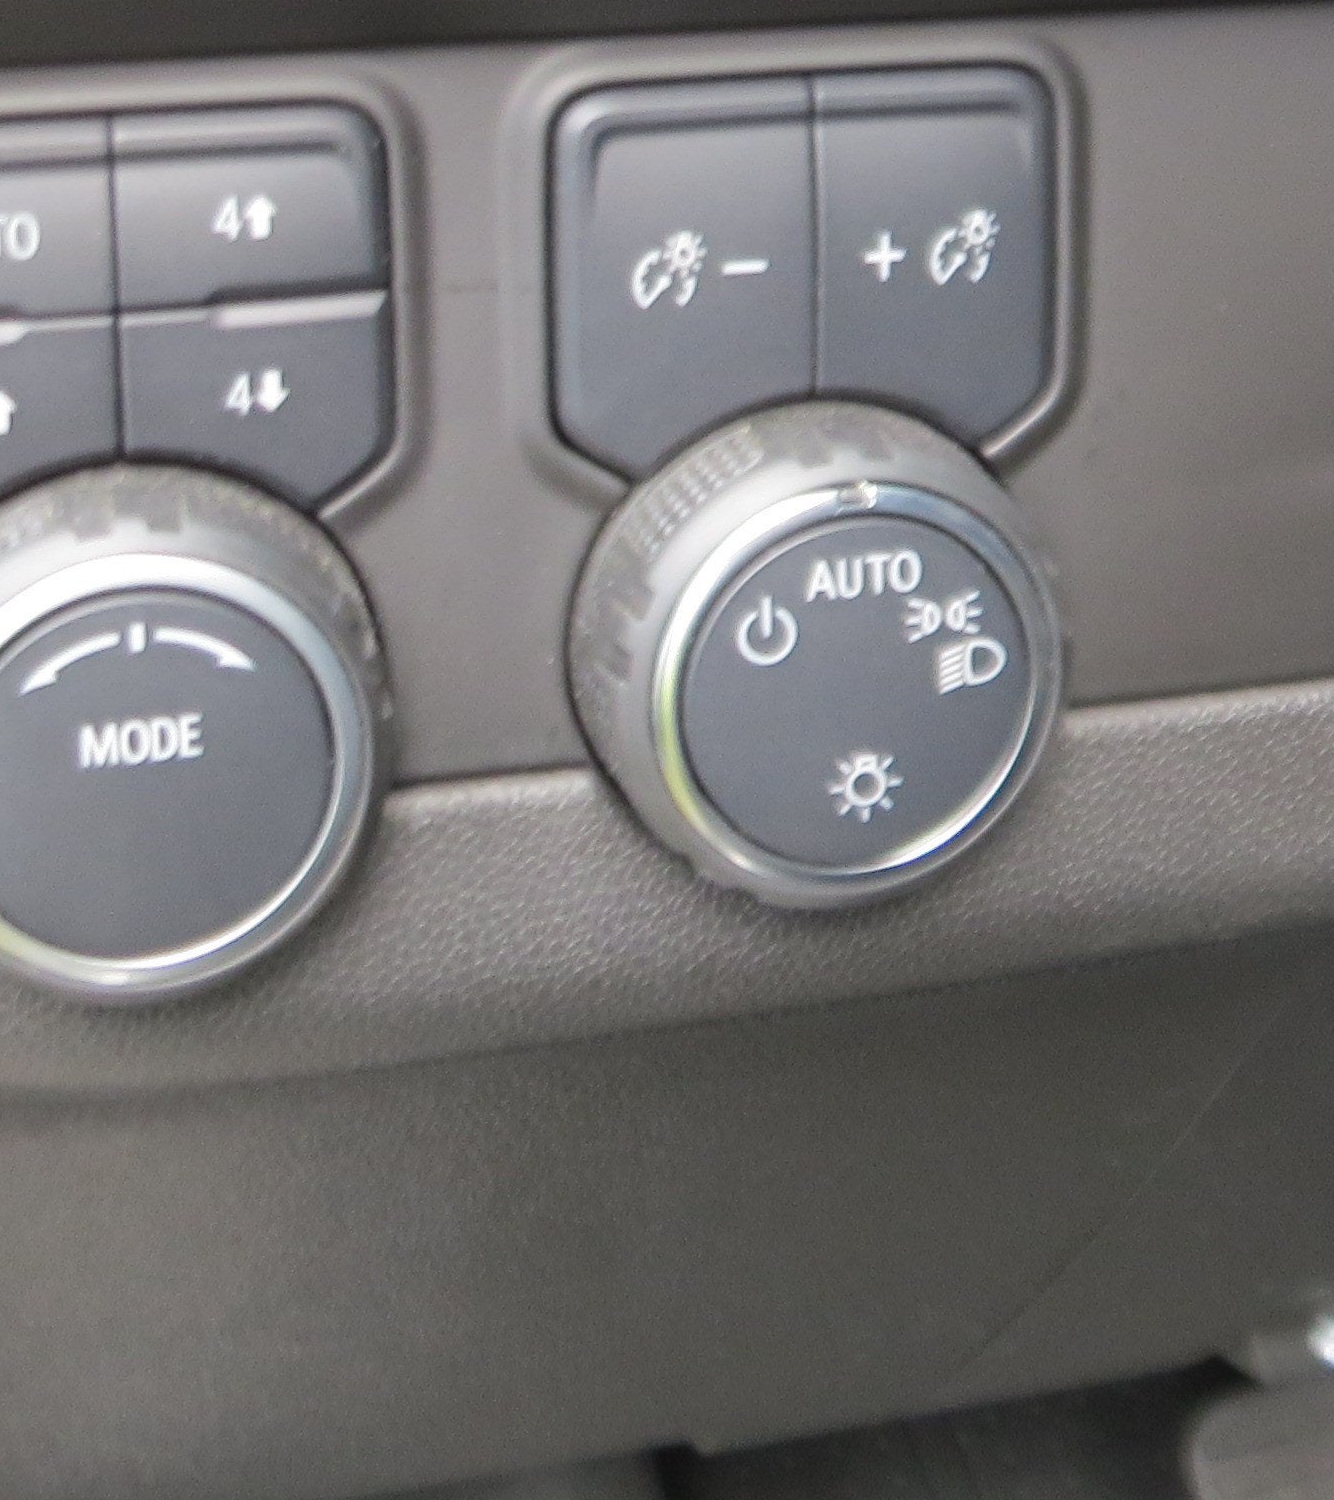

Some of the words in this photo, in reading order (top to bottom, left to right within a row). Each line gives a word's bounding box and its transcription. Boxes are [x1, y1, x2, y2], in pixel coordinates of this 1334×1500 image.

[211, 195, 241, 240] 4
[224, 371, 251, 415] 4
[805, 550, 923, 602] AUTO
[78, 711, 205, 769] MODE
